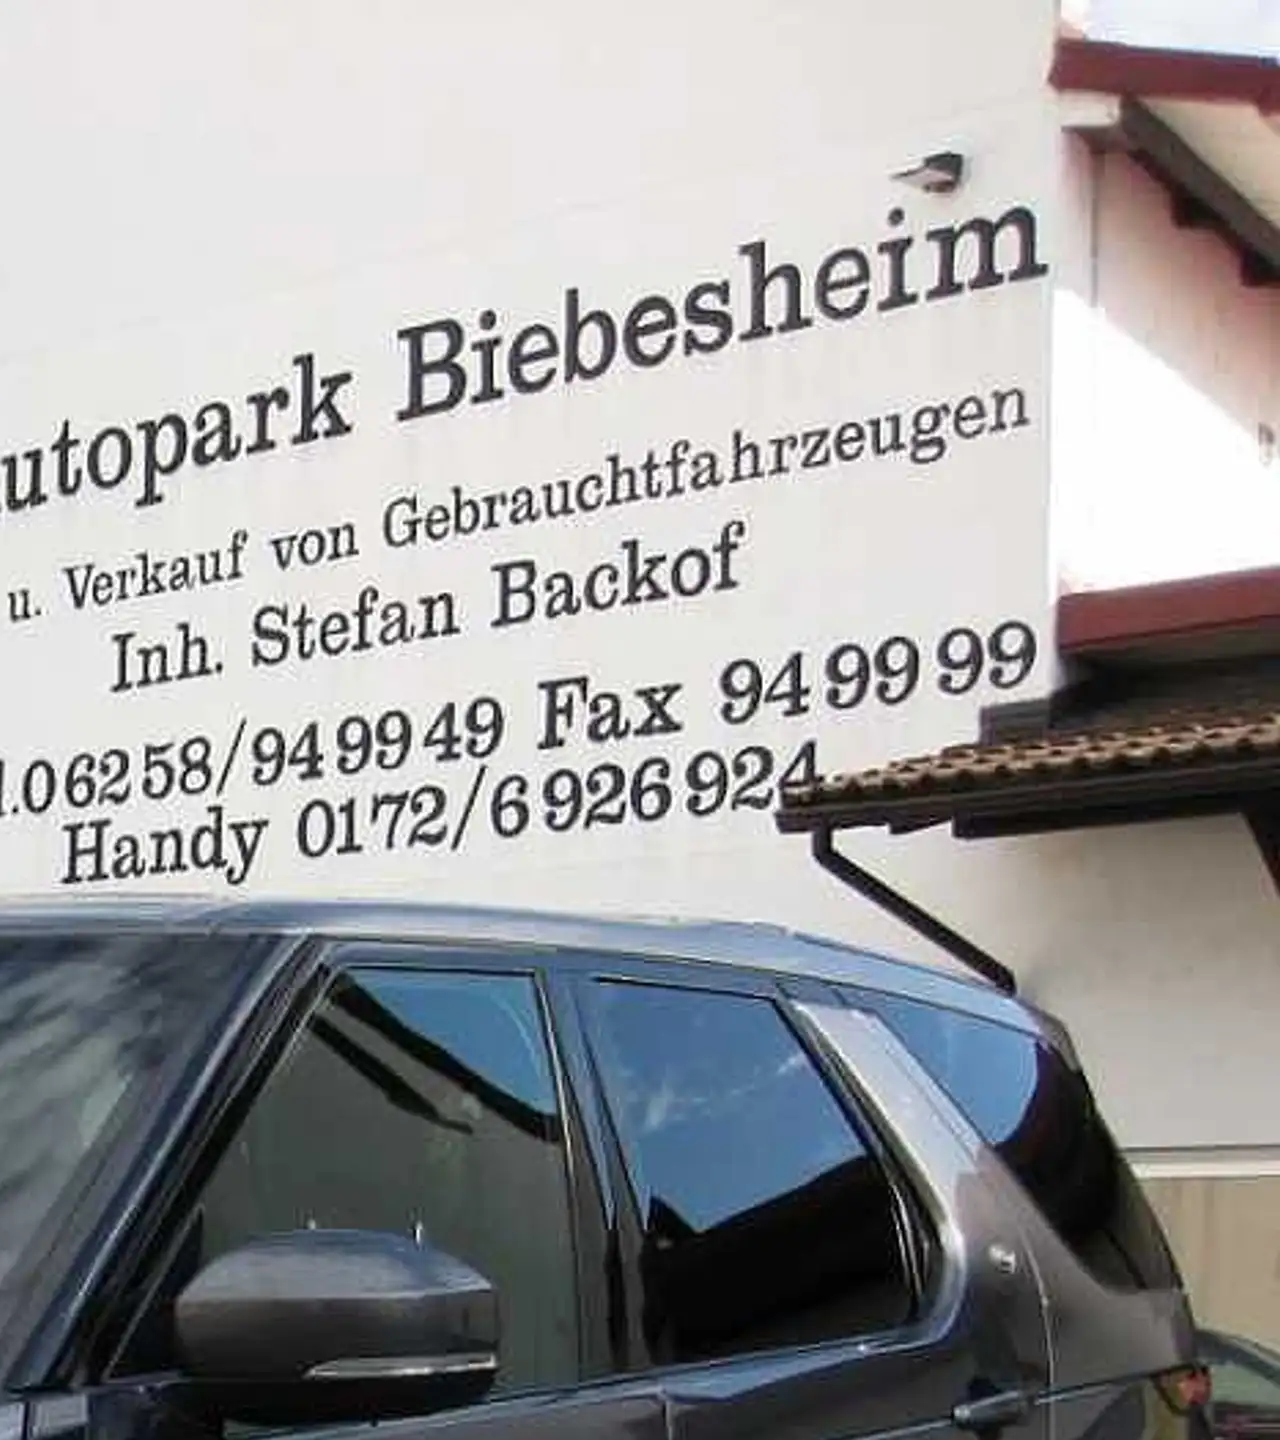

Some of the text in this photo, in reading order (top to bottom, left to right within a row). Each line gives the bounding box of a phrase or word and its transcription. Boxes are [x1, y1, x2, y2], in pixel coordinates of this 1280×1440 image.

[395, 204, 1050, 424] Biebesheim
[6, 587, 42, 624] u.
[62, 529, 250, 610] Verkauf
[269, 521, 361, 571] von
[382, 386, 1031, 548] Gebrauchtfahrzeugen
[110, 519, 747, 694] Inh. Stefan Backof
[536, 675, 684, 751] Fax
[59, 804, 270, 887] Handy
